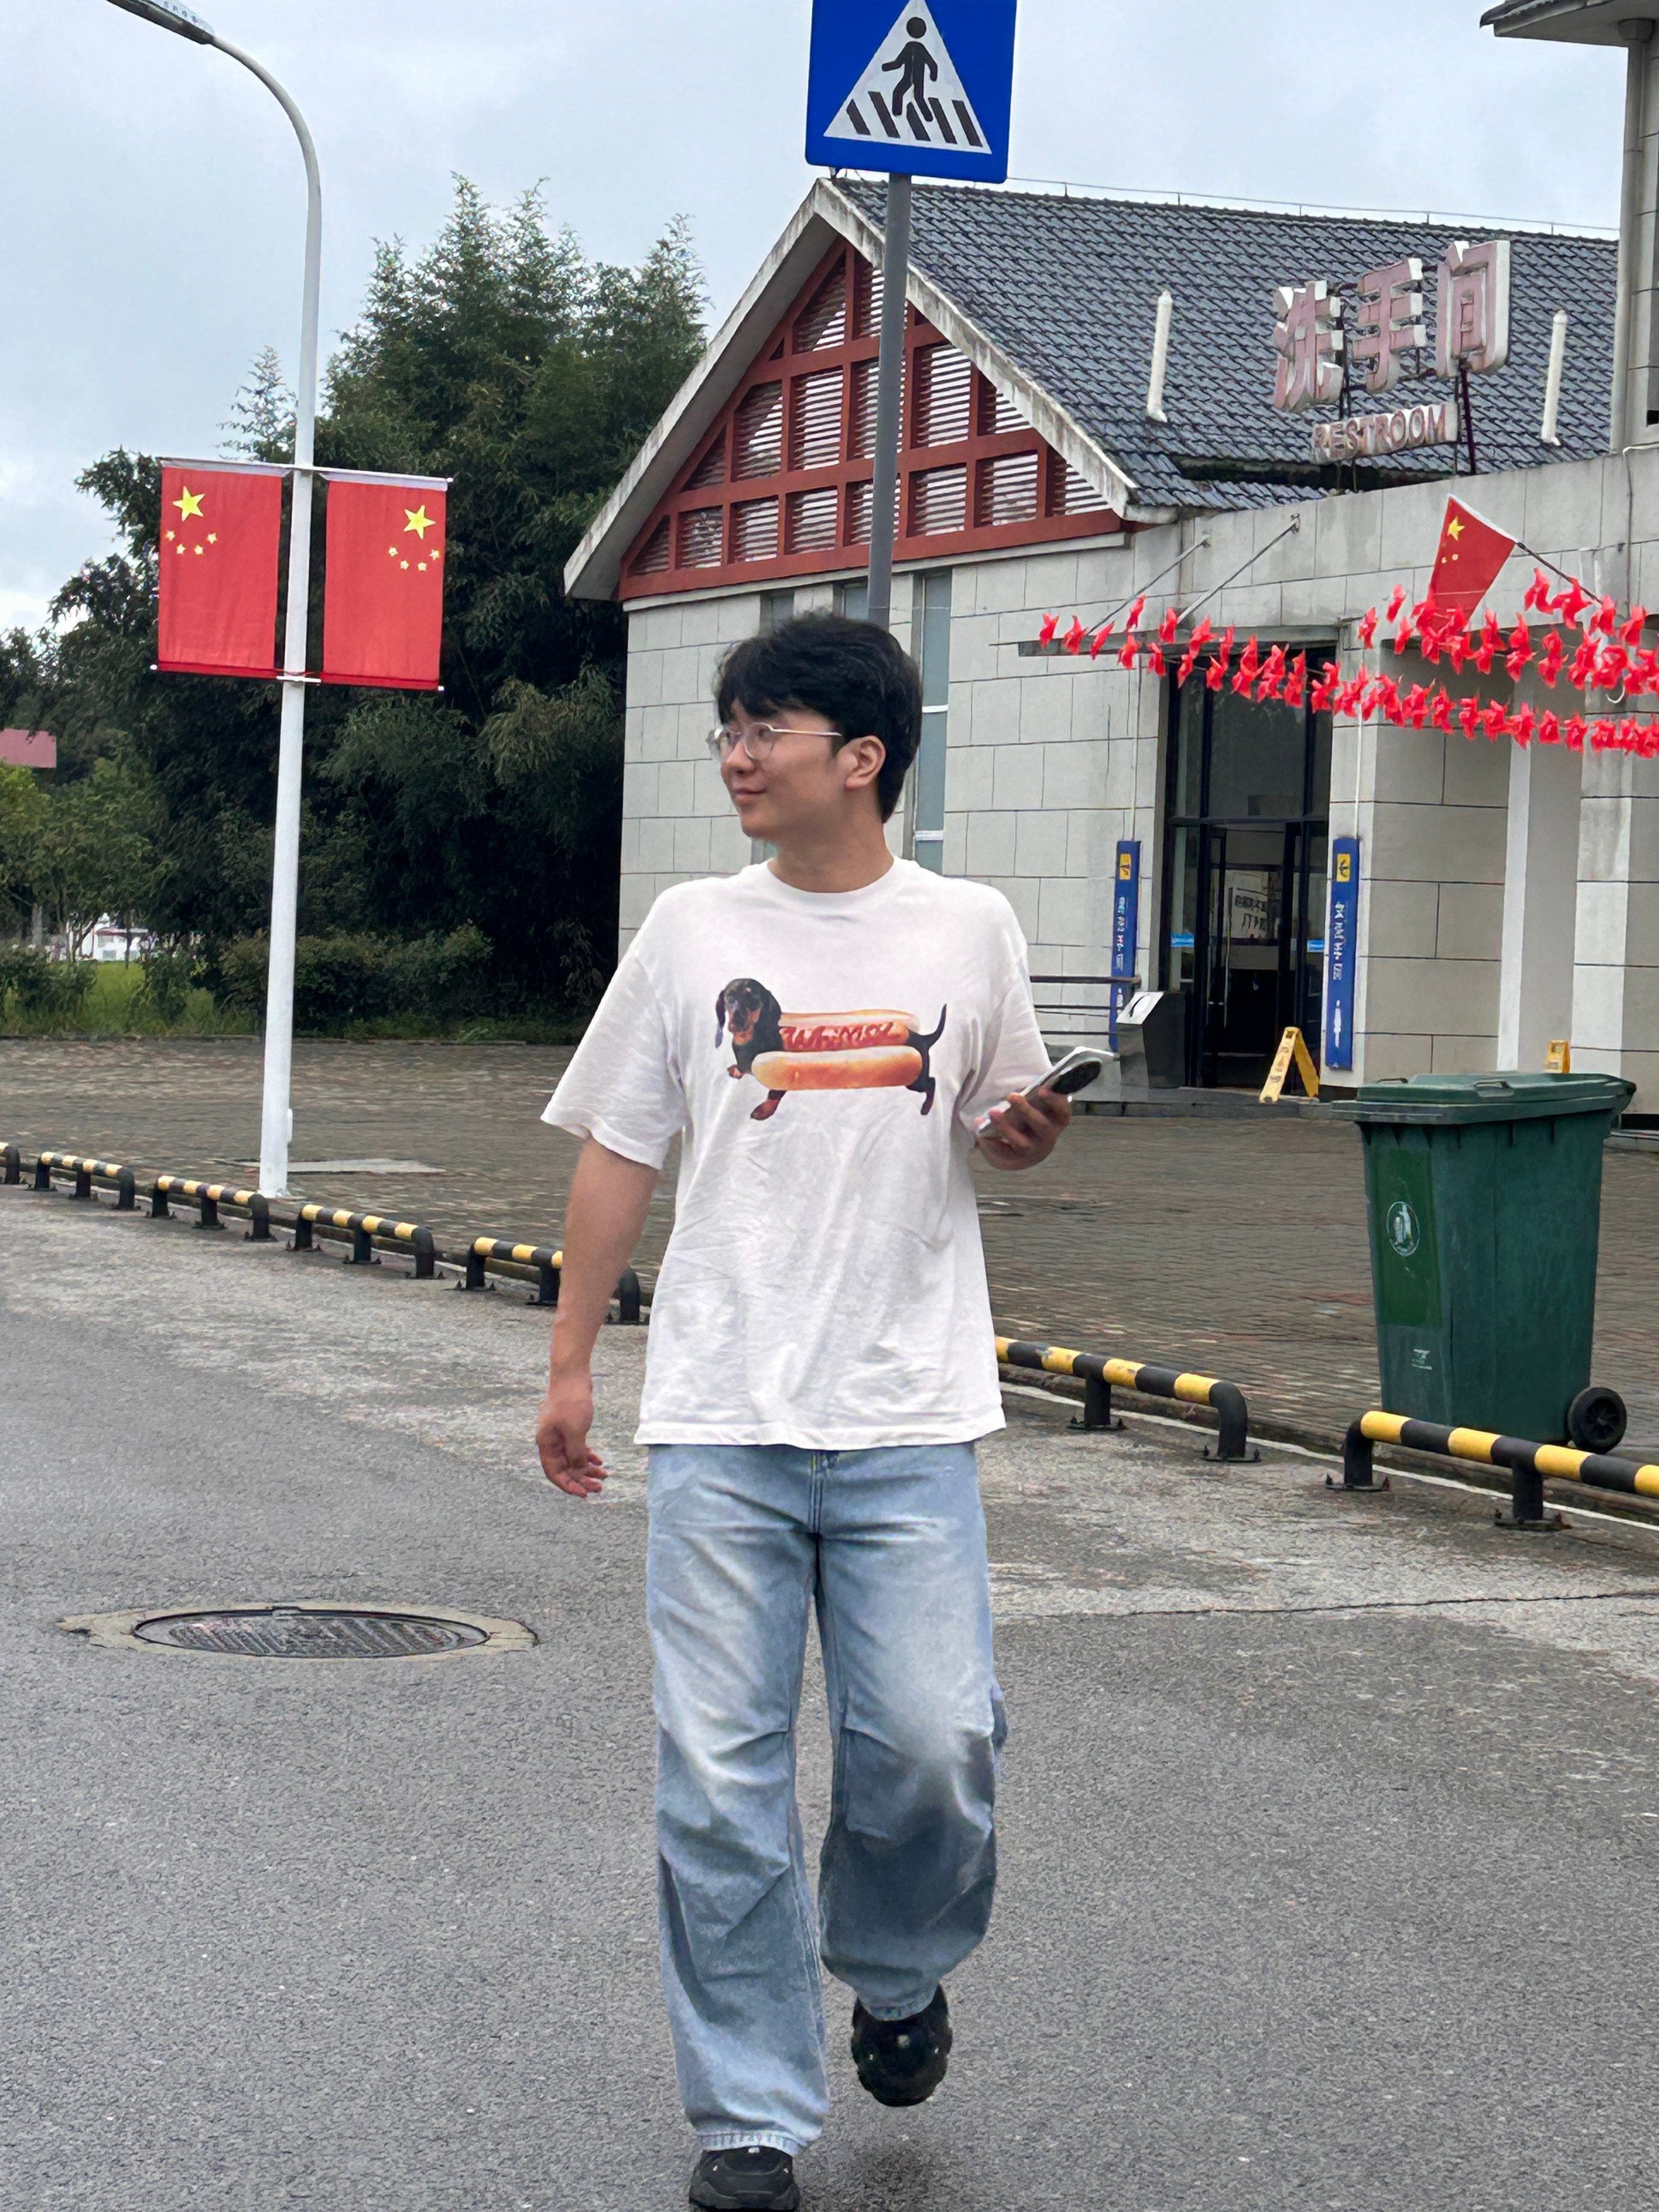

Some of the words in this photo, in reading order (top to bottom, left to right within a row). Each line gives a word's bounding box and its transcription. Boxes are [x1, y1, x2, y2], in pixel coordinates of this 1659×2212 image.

[1273, 240, 1511, 413] 洗手间
[1312, 402, 1457, 464] RESTROOM
